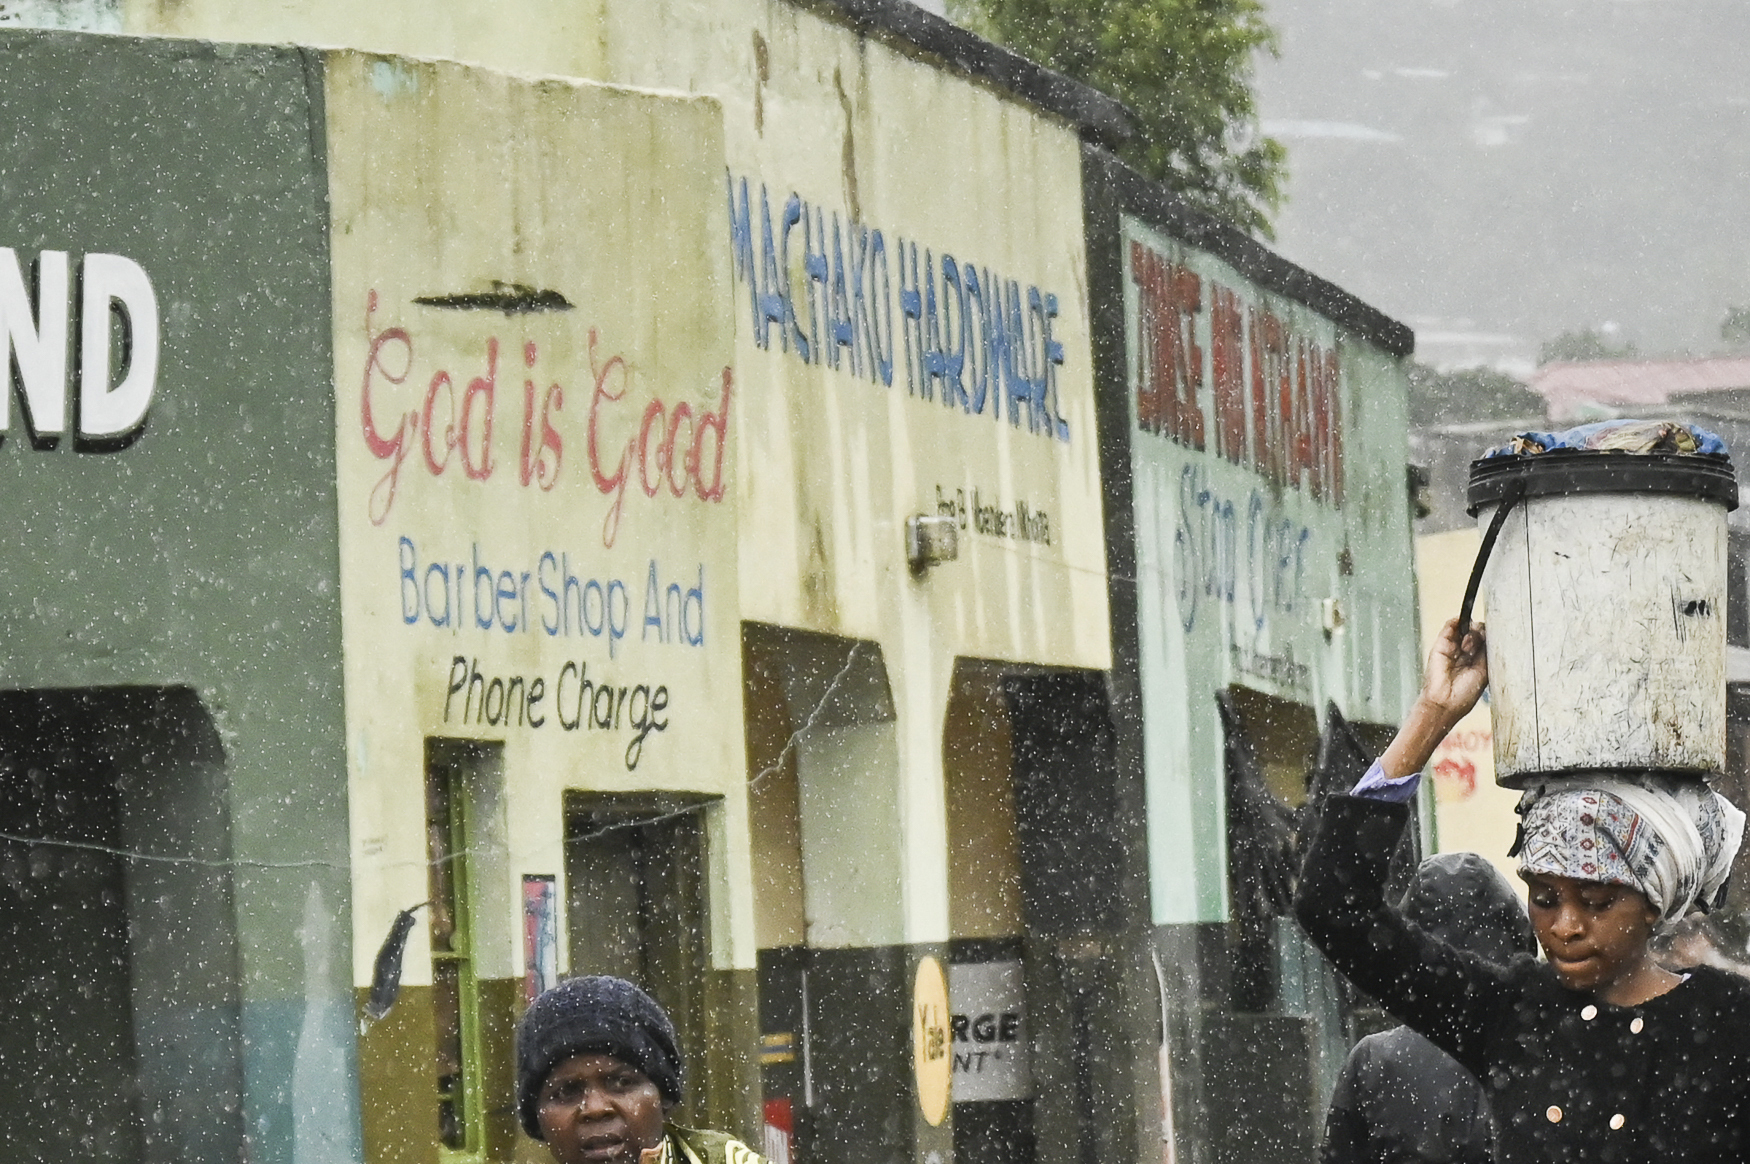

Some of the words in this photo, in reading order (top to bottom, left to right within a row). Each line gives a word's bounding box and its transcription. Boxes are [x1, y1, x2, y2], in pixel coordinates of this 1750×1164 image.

[0, 246, 159, 446] ND
[361, 288, 499, 526] God
[519, 339, 564, 493] is
[587, 326, 733, 549] Good
[641, 558, 704, 647] And
[442, 655, 546, 729] Phone
[556, 659, 670, 772] Charge
